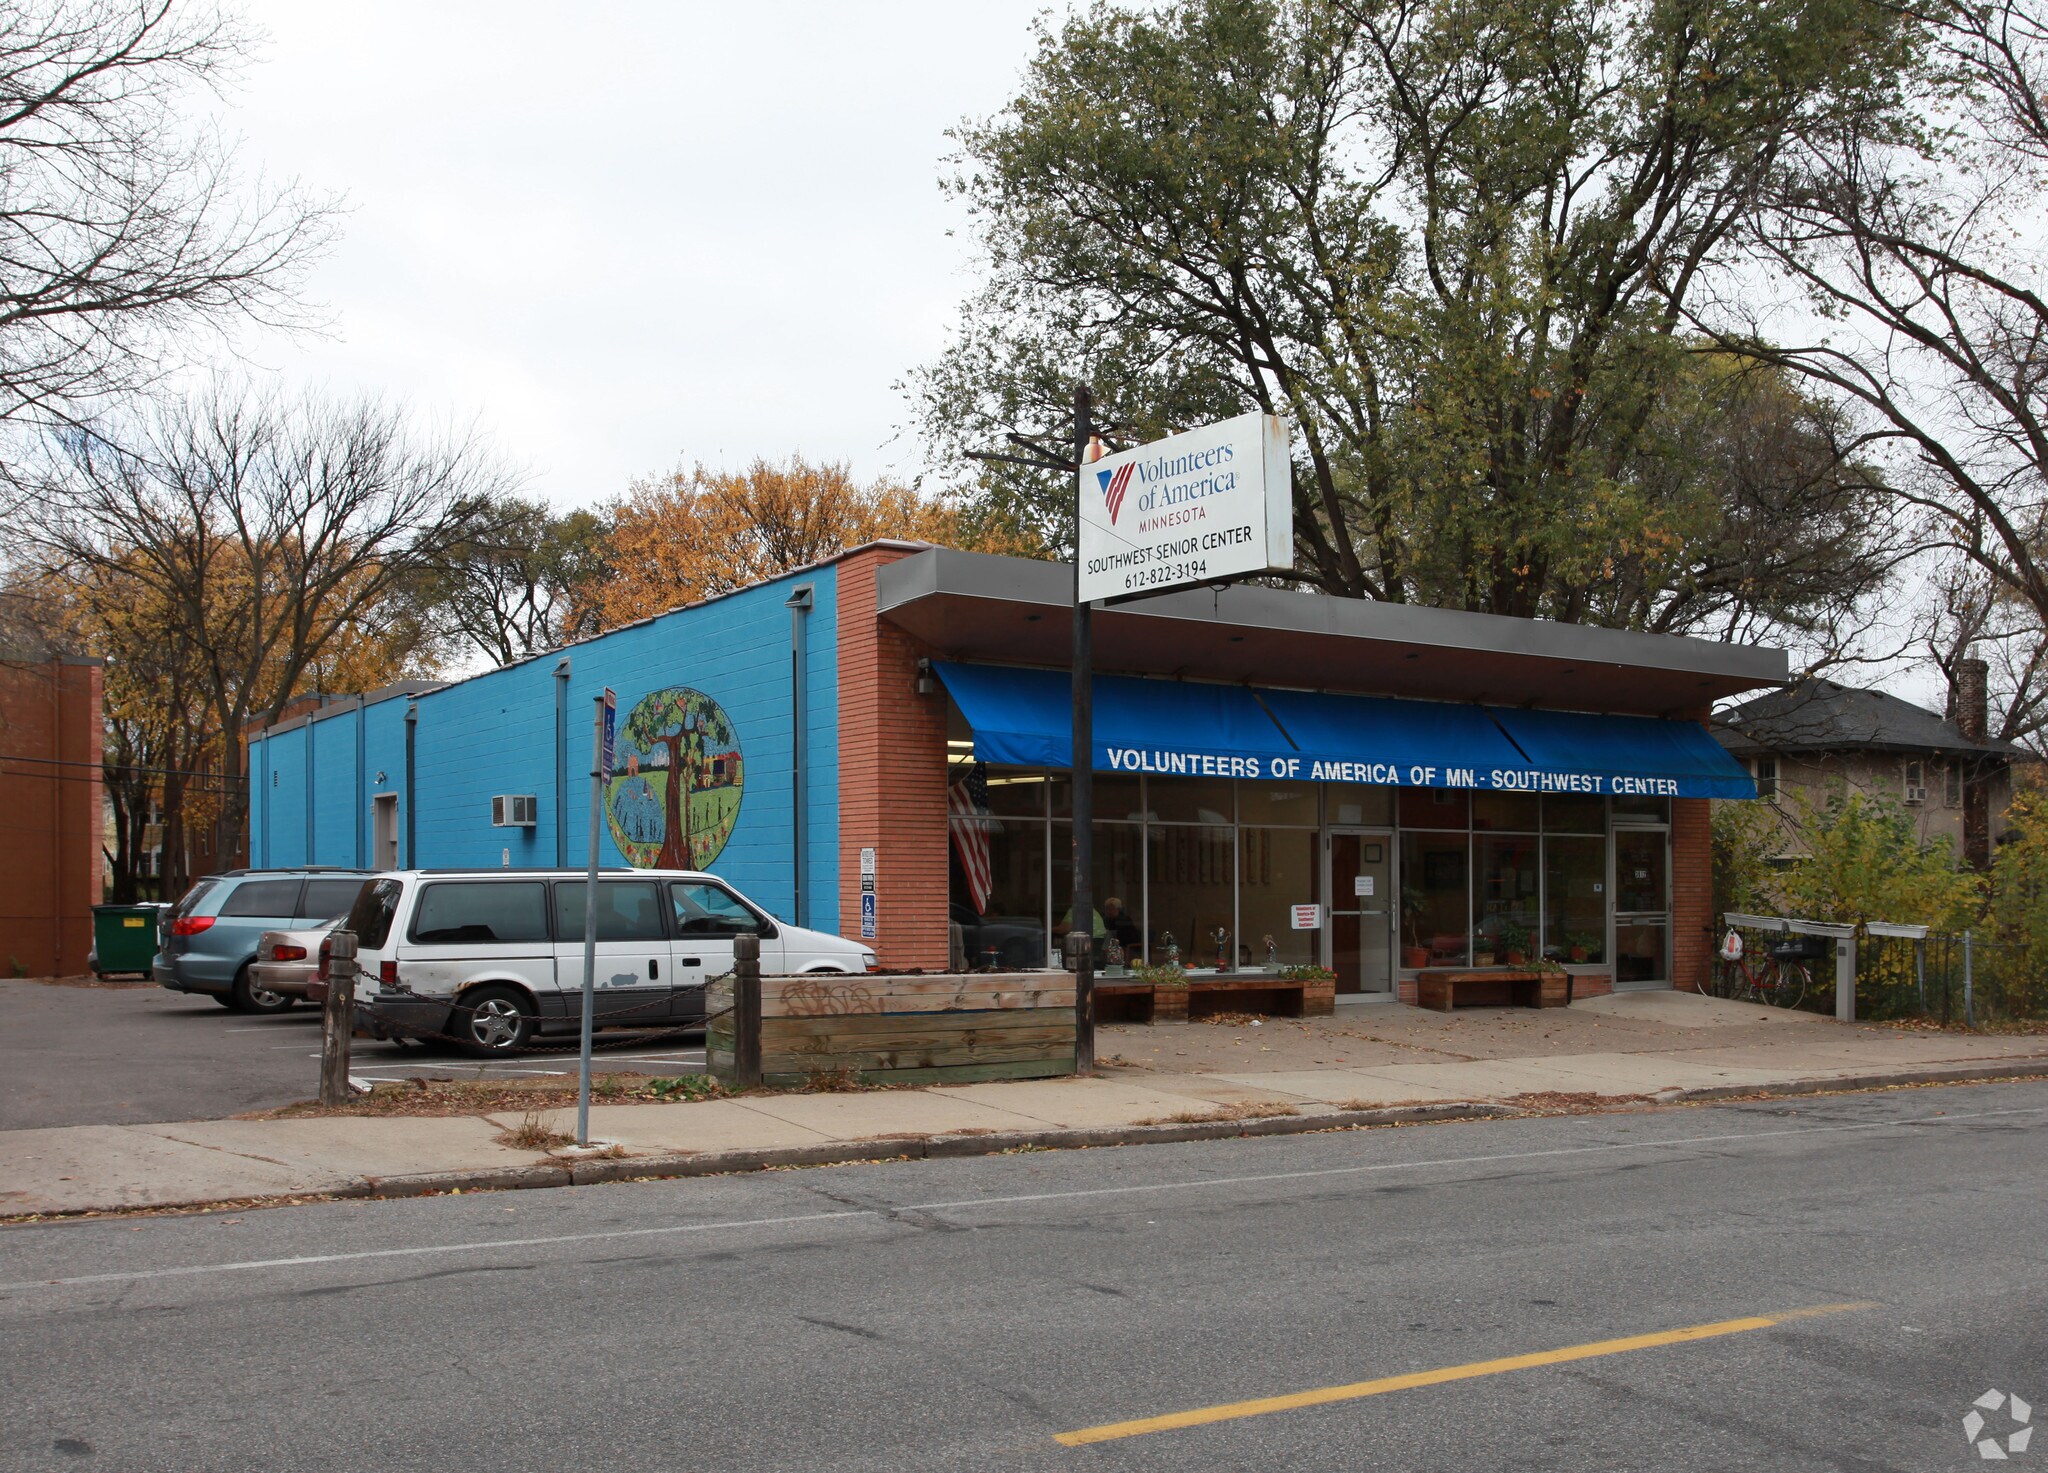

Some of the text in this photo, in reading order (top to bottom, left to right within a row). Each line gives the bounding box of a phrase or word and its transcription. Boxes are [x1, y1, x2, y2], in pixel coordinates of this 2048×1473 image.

[1137, 443, 1233, 484] Volunteers
[1138, 484, 1158, 512] of
[1138, 506, 1206, 534] MINNESOTA
[1088, 525, 1252, 575] SOUTHWEST SENIOR CENTER
[1125, 559, 1207, 589] 612-822-3194
[1107, 748, 1260, 778] VOLUNTEERS
[1270, 758, 1300, 778] OF
[1310, 760, 1399, 784] AMERICA
[1410, 765, 1436, 786] OF
[1491, 769, 1603, 793] SOUTHWEST
[1611, 775, 1679, 796] CENTER
